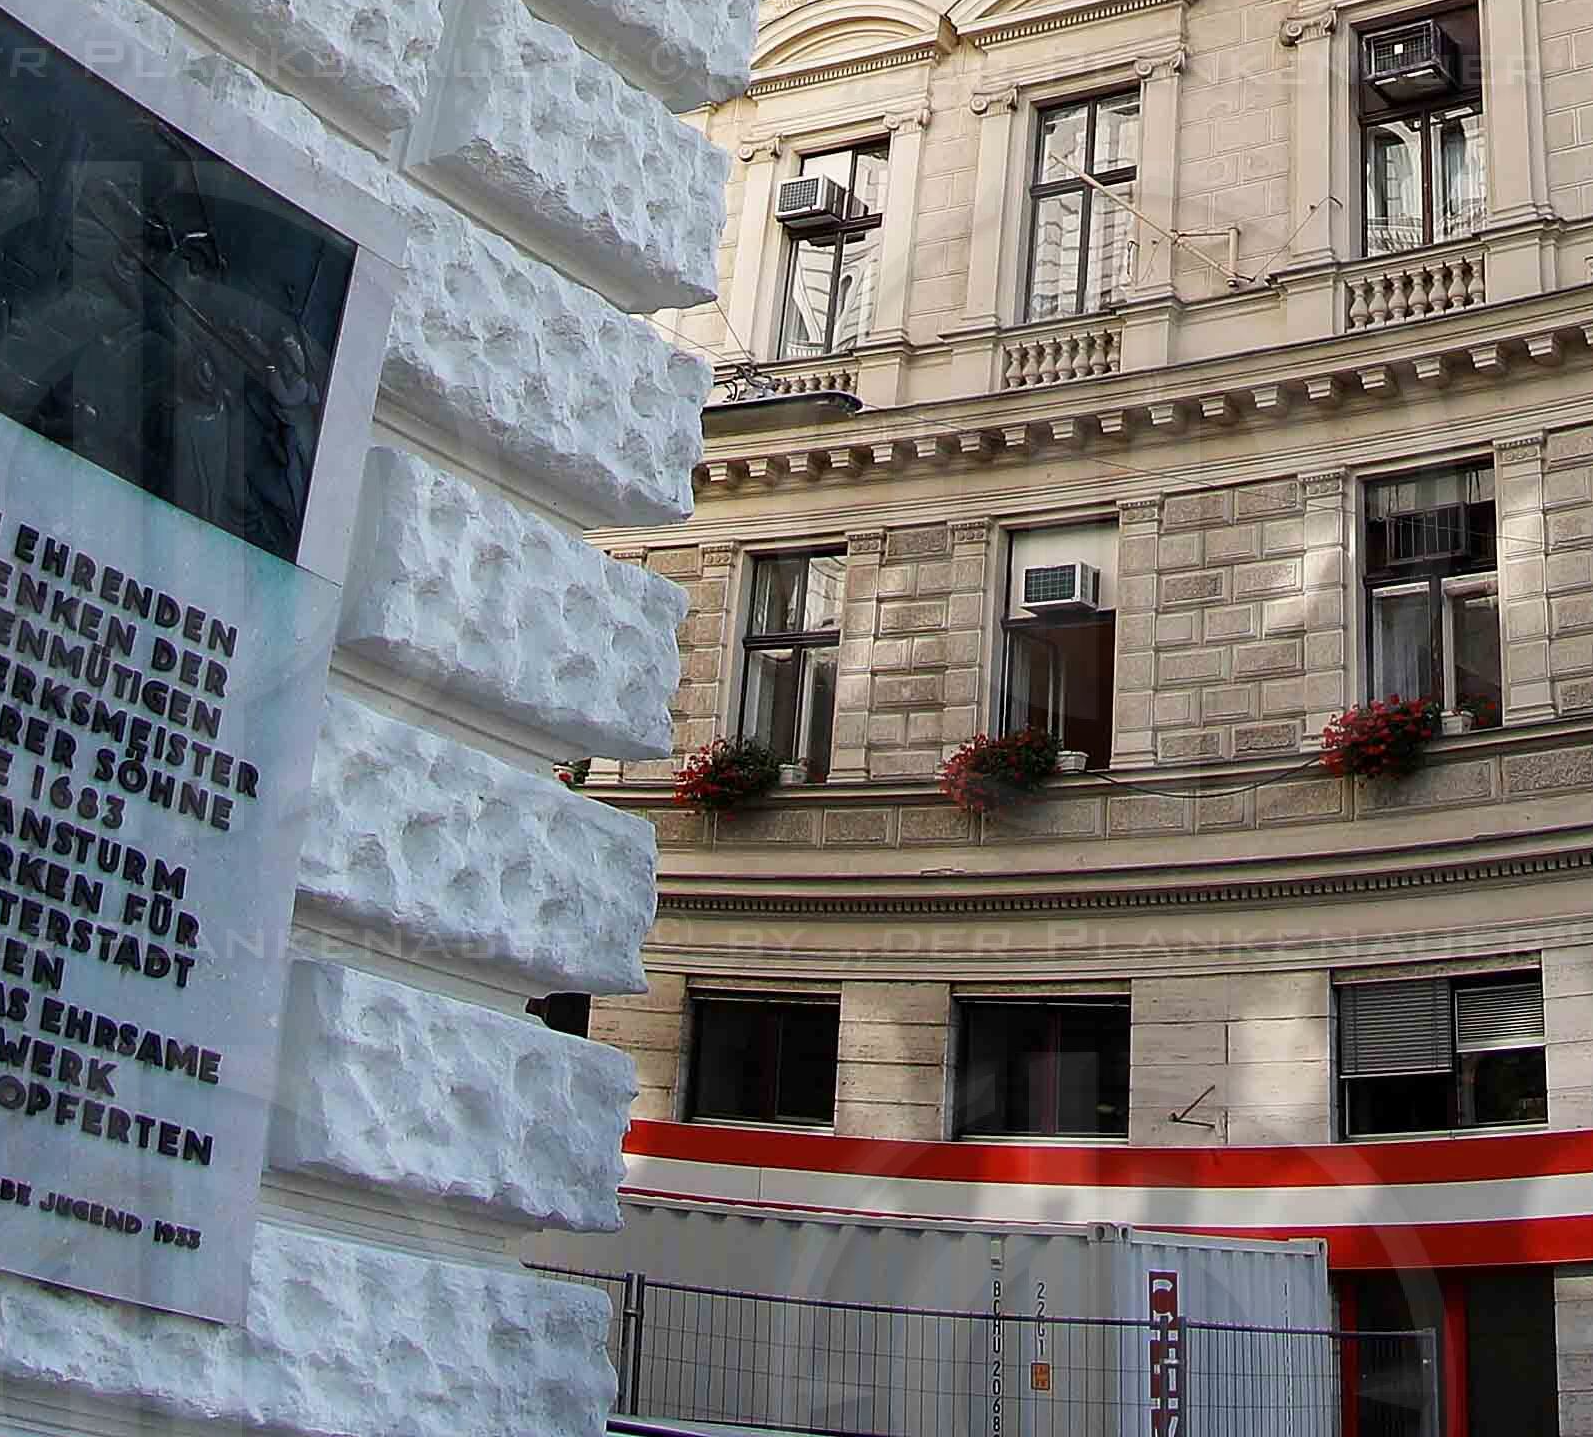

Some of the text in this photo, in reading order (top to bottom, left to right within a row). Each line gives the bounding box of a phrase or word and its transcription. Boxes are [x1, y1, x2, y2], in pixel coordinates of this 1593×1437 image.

[14, 524, 239, 659] EHRENDEN
[151, 636, 229, 699] DER
[30, 764, 127, 830] 1683
[95, 736, 235, 832] SÖHNE
[122, 892, 202, 950] FÜR
[39, 996, 225, 1087] EHRSAME
[38, 1191, 144, 1235] JUGEND
